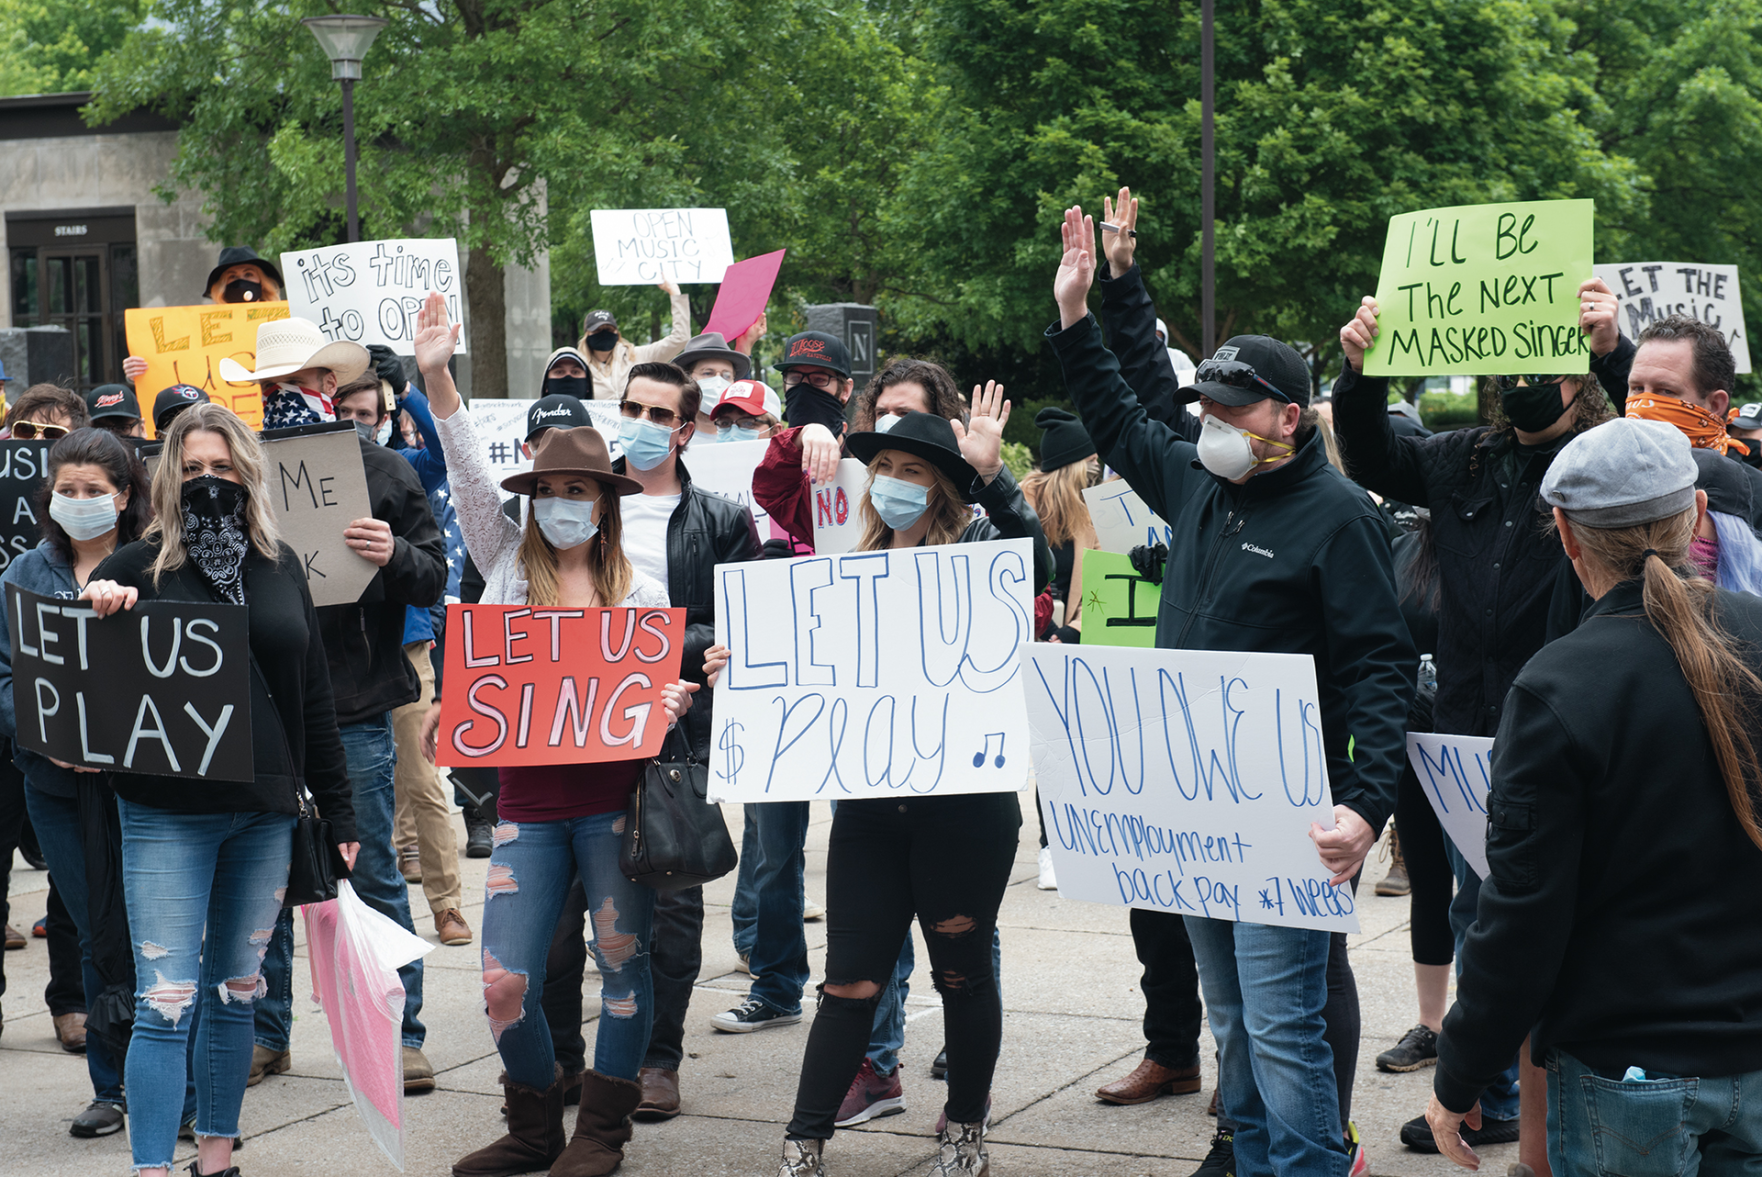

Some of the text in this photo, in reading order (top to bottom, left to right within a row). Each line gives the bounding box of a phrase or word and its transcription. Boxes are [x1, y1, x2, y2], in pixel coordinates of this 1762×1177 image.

[54, 224, 88, 237] STAIRS
[633, 210, 694, 239] OPEN
[617, 237, 700, 259] MUSIC
[369, 243, 453, 293] time
[638, 259, 702, 281] CITY
[1676, 268, 1728, 300] THE
[319, 306, 365, 342] to
[853, 333, 868, 362] N
[531, 403, 572, 425] Fender
[13, 496, 37, 525] A
[816, 486, 849, 529] NO
[1247, 543, 1275, 559] Columbia
[15, 592, 224, 679] LET US
[462, 608, 671, 669] LET US
[723, 550, 1031, 694] LET US
[34, 677, 235, 776] PLAY
[451, 671, 653, 759] SING
[1031, 654, 1325, 808] YOU OWE US
[1416, 742, 1492, 815] MU
